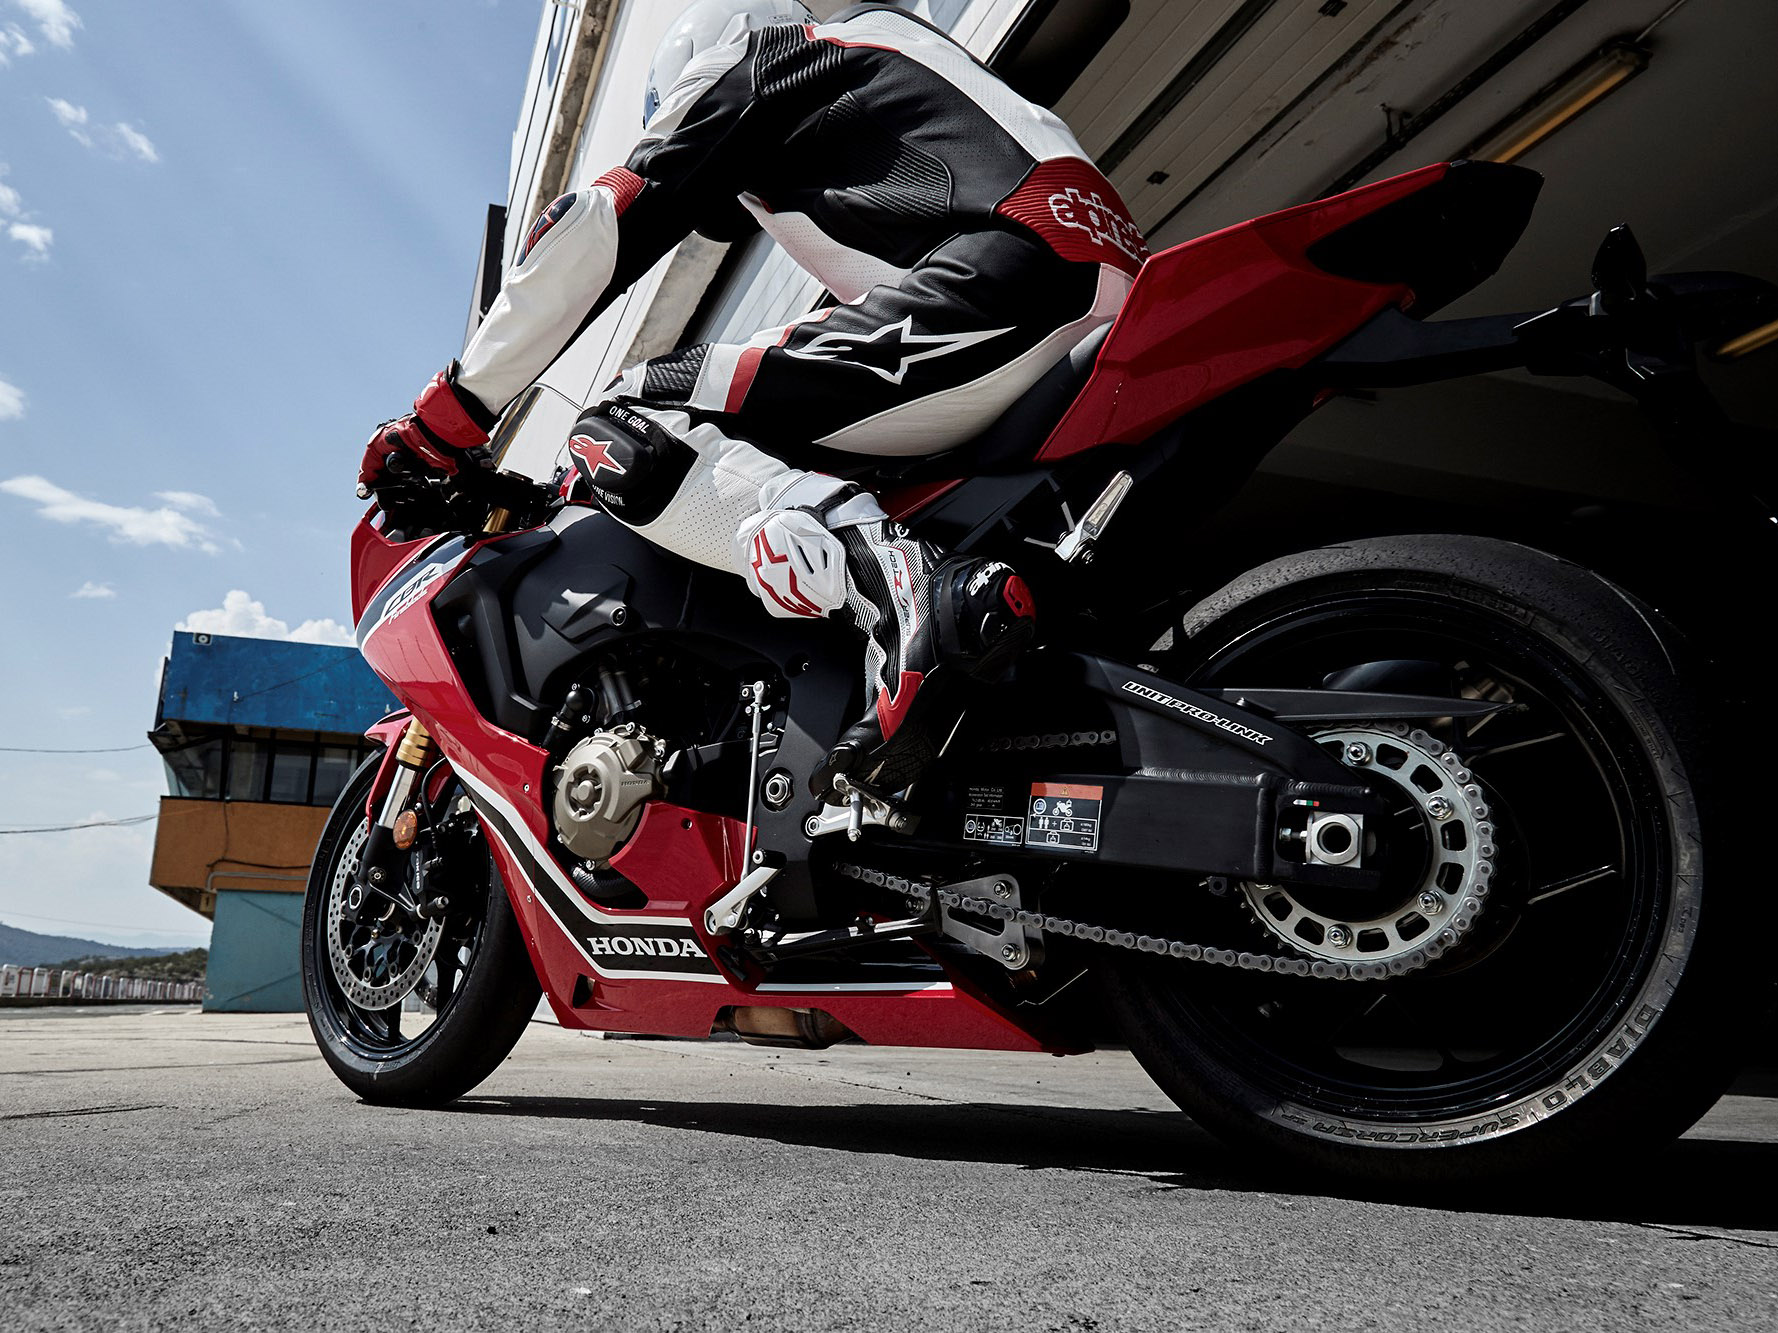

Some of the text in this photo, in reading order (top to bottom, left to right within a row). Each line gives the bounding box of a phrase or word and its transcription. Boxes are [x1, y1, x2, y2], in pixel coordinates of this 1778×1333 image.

[609, 405, 650, 434] ONE GOAL
[1122, 681, 1273, 746] UNIT PRO-LINK
[587, 937, 707, 958] HONDA
[1542, 1003, 1658, 1111] DIABLO
